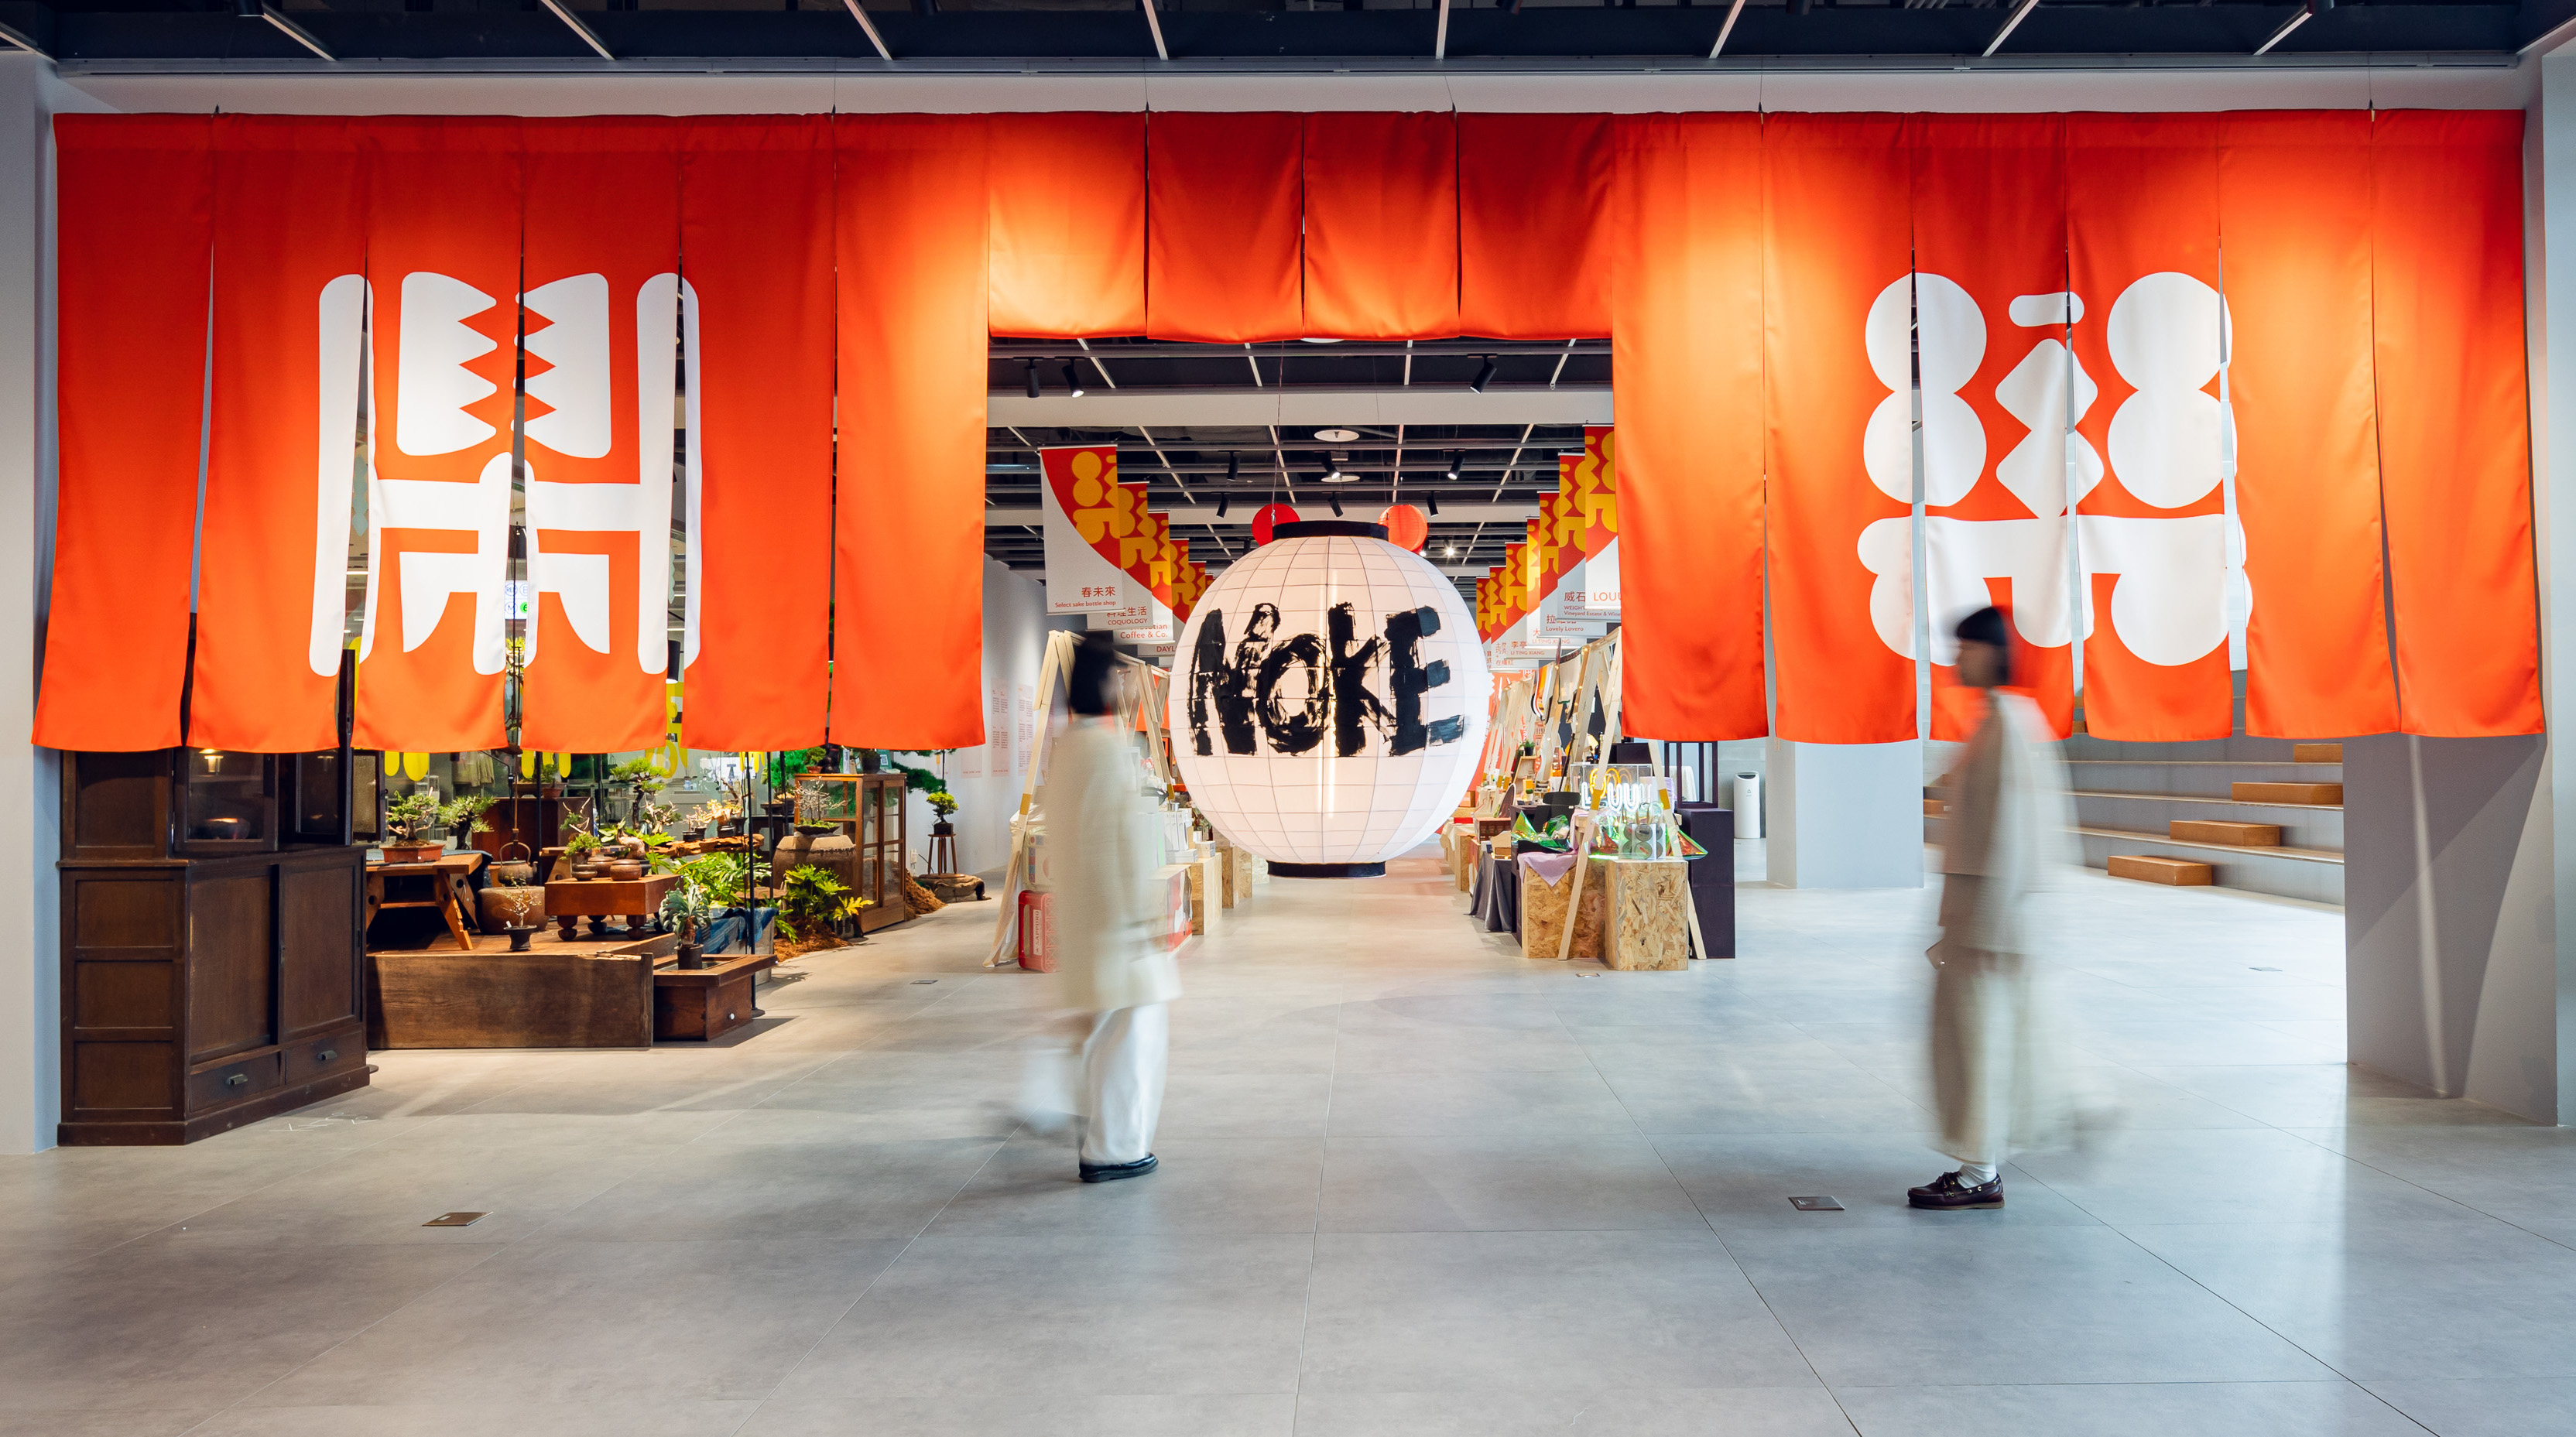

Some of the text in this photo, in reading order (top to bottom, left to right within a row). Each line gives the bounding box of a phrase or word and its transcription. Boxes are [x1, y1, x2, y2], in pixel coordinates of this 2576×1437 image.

[1081, 586, 1115, 597] 春未來
[1564, 591, 1585, 602] 威石
[1120, 631, 1146, 639] Coffee
